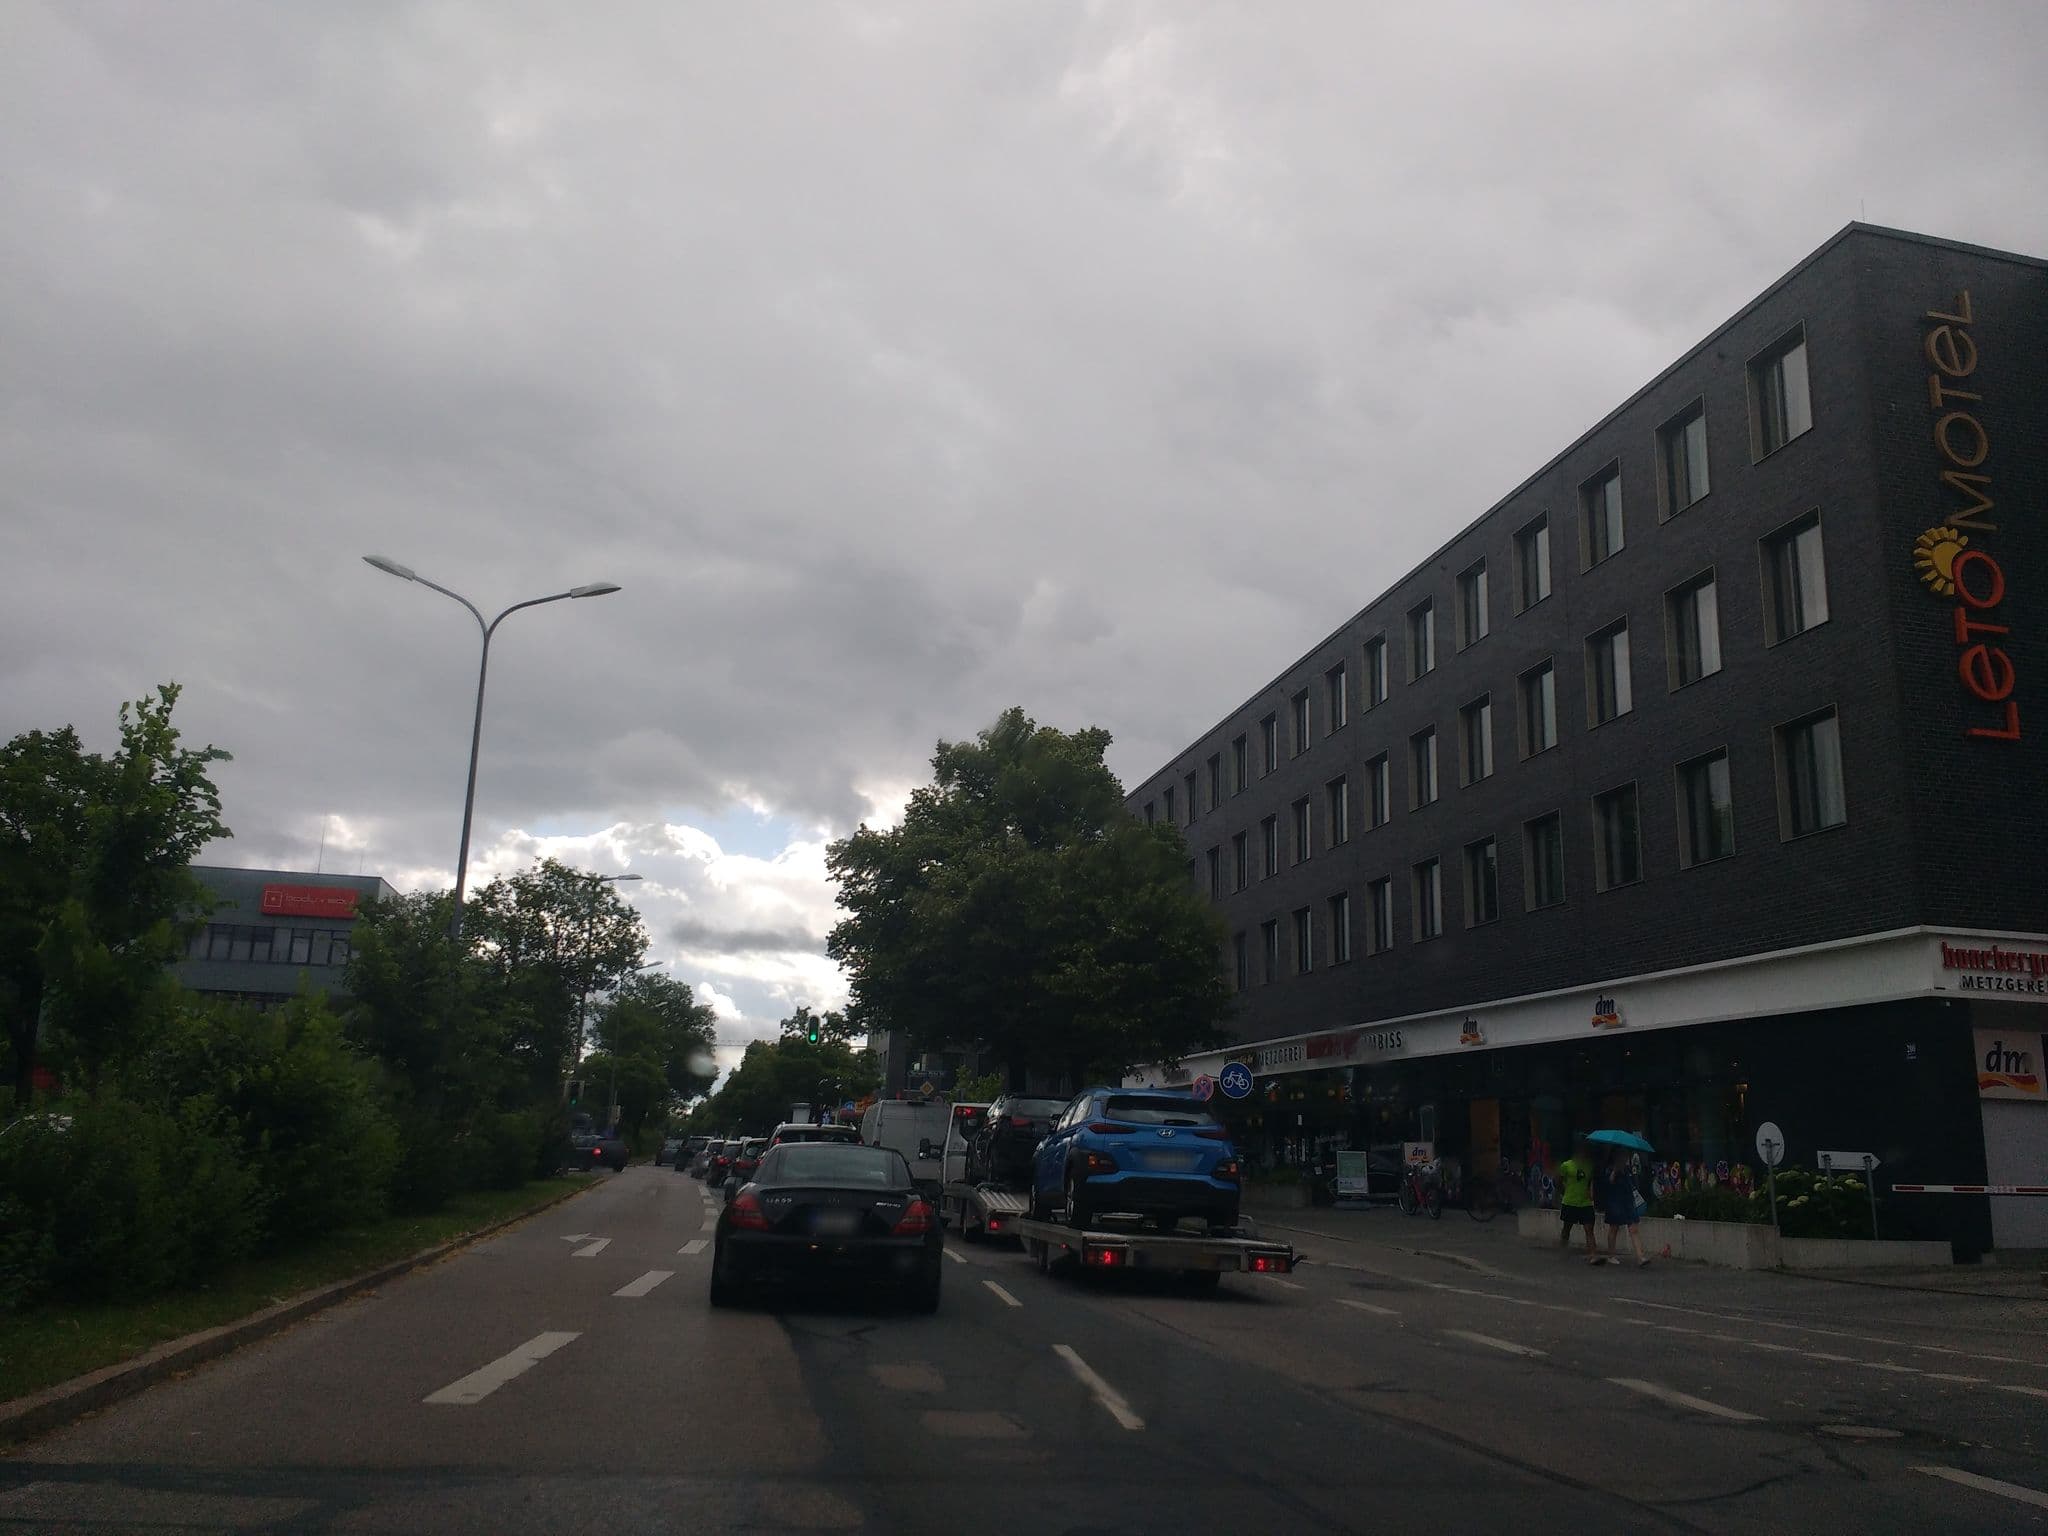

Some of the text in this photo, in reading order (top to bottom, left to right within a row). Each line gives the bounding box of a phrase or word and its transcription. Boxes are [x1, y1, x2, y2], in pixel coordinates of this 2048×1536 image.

[1595, 995, 1615, 1016] dm
[1462, 1016, 1478, 1033] dm
[1361, 1031, 1402, 1049] BISS
[1985, 1040, 2032, 1074] dm
